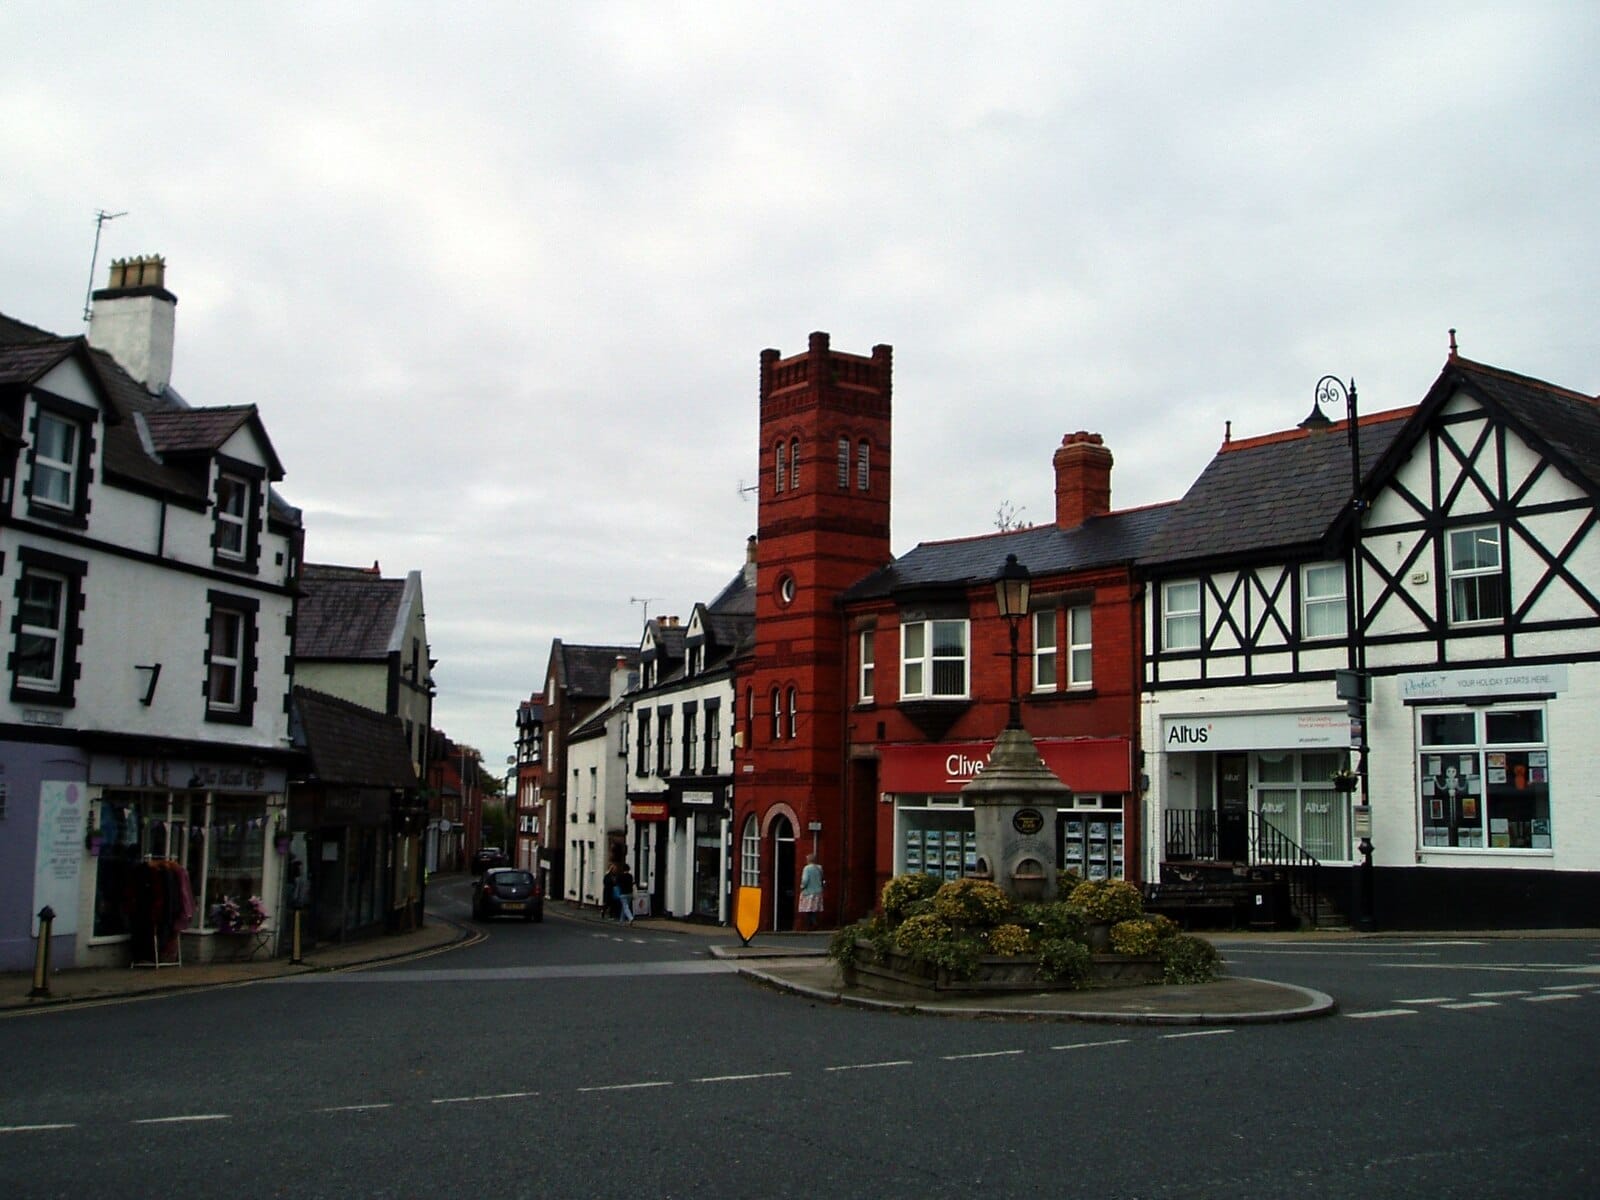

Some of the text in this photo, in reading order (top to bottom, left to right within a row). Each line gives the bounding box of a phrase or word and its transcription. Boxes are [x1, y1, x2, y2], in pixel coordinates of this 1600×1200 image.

[1457, 680, 1476, 688] YOUR
[1477, 678, 1502, 687] HOLIDAY
[1504, 677, 1529, 686] STARTS
[1168, 725, 1208, 743] Altus
[946, 754, 984, 776] Clive
[1305, 803, 1328, 813] Altus
